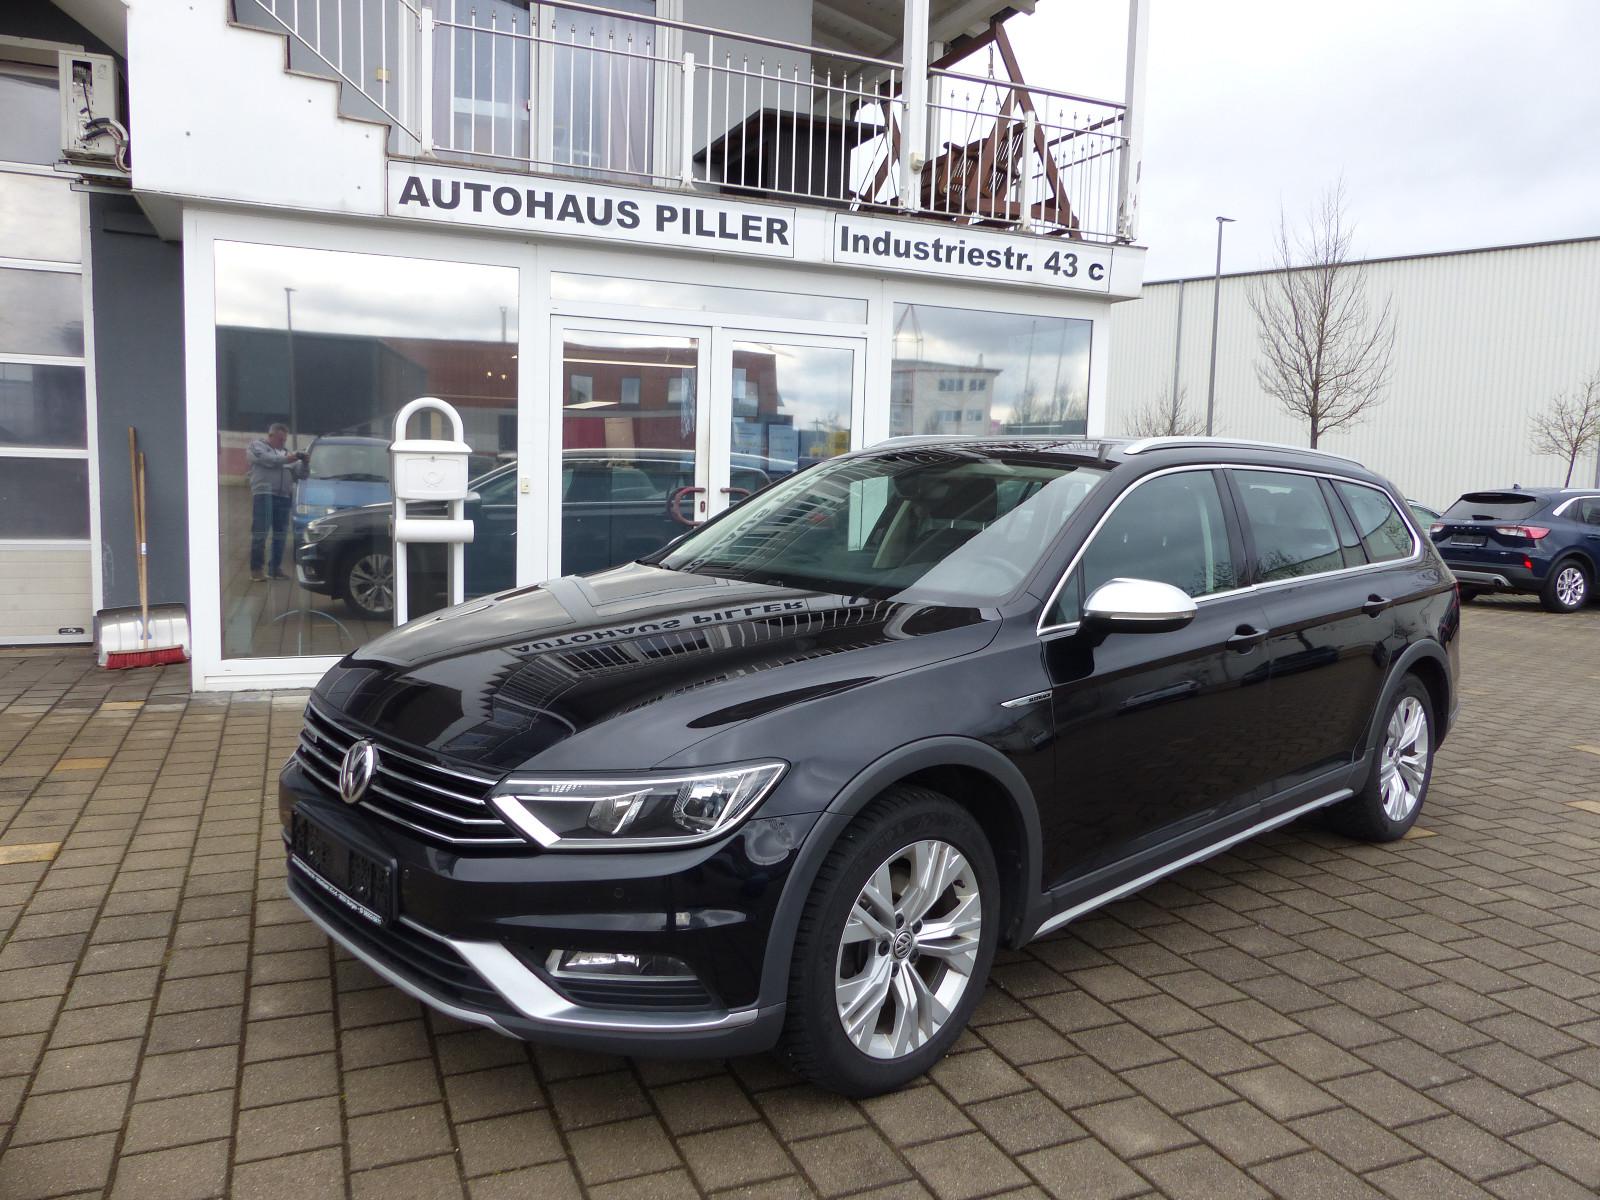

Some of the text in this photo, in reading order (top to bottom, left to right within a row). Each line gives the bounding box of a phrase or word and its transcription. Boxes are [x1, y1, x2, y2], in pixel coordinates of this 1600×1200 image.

[398, 175, 790, 246] AUTOHAUS PILLER
[840, 225, 1105, 281] Industriestr. 43 c
